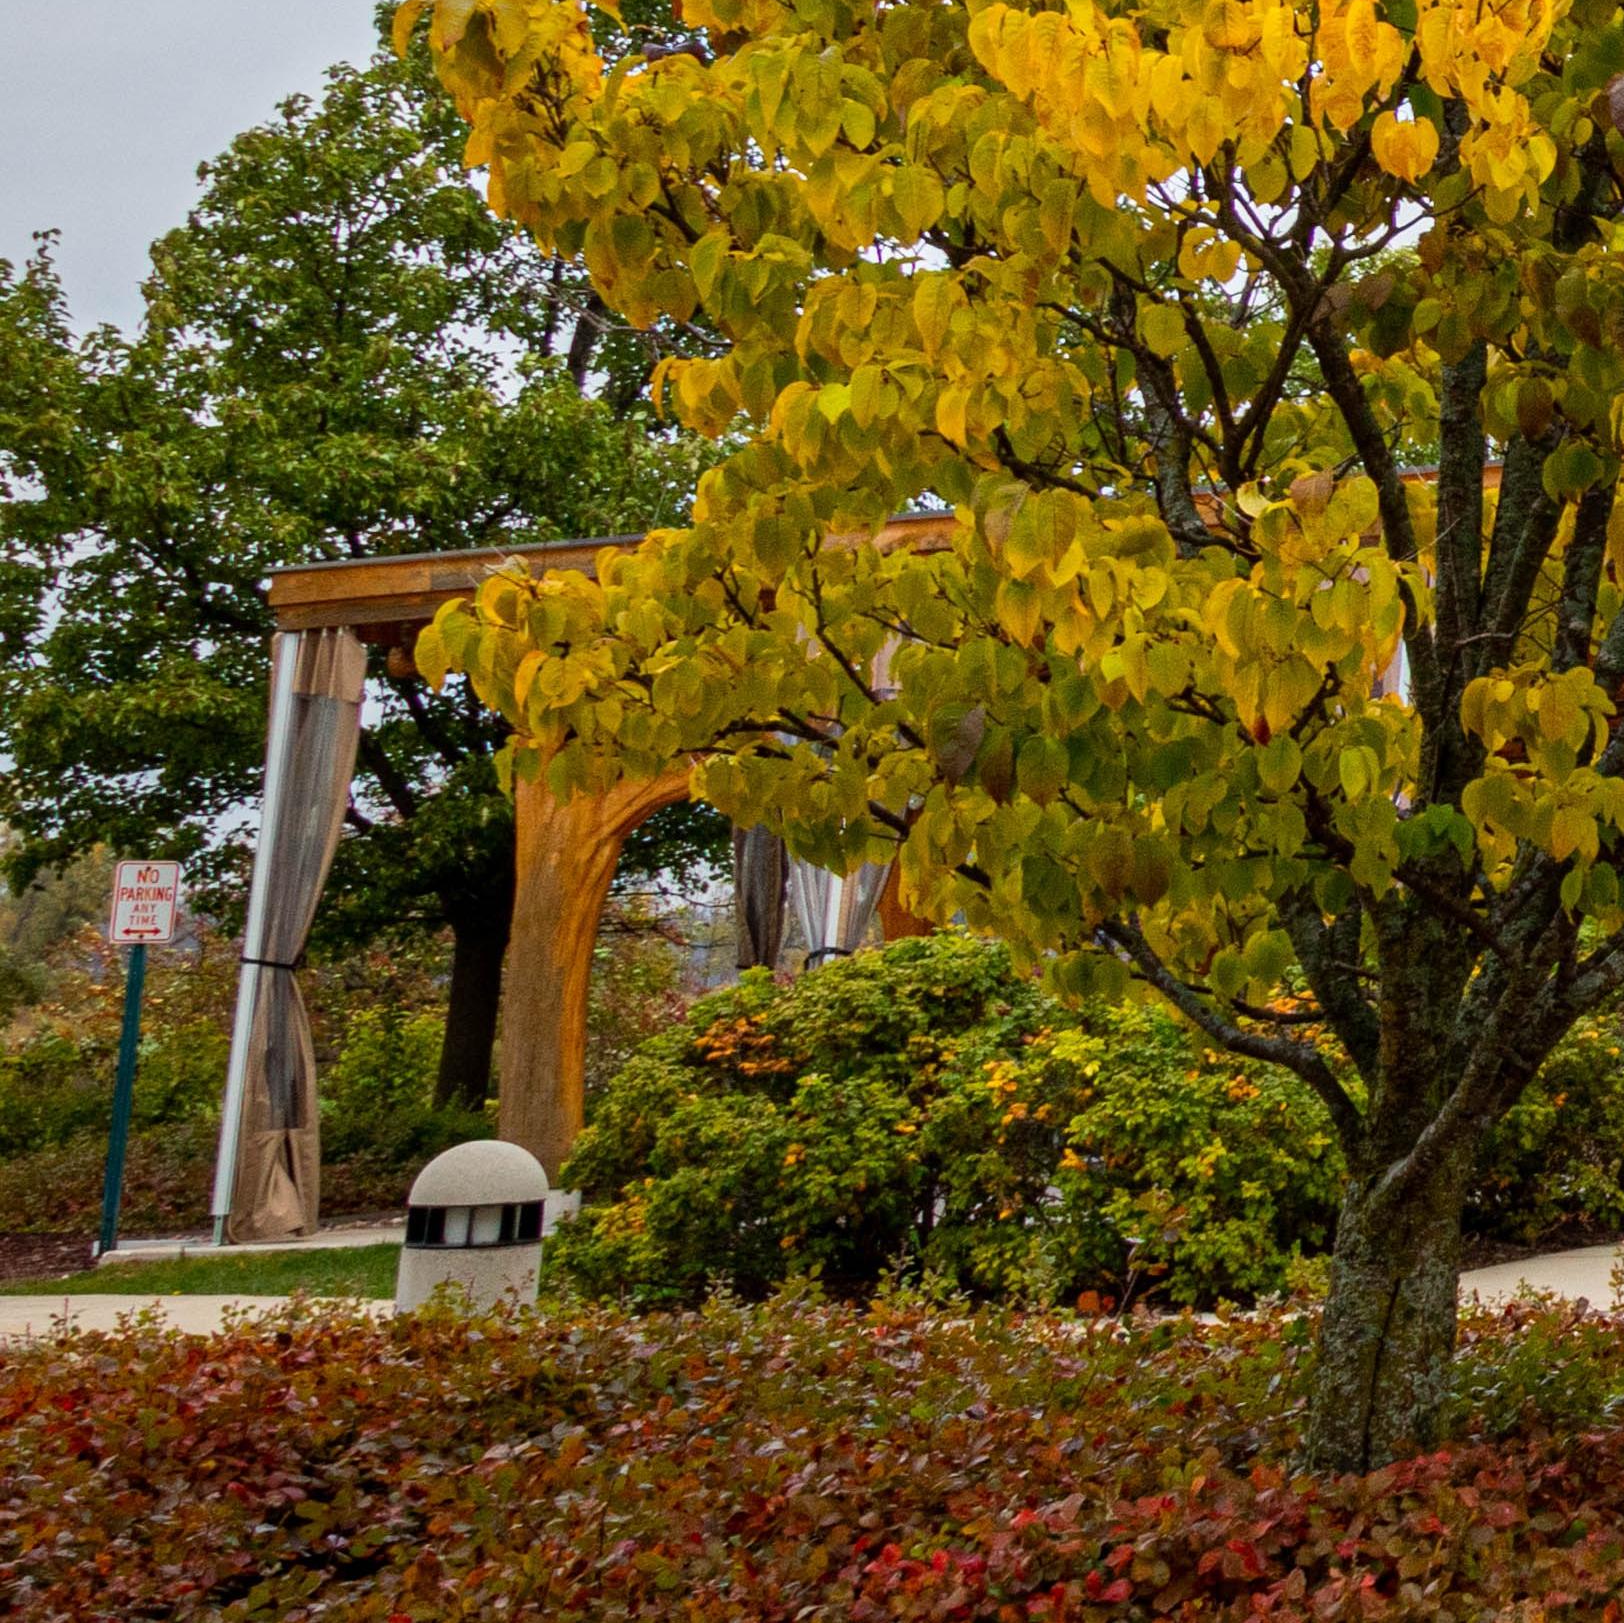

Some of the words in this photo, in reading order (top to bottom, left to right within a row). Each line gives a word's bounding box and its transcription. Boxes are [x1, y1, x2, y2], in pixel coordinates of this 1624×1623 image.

[137, 869, 160, 884] NO
[119, 887, 172, 902] PARKING
[132, 904, 158, 913] ANY
[129, 915, 158, 926] TIME
